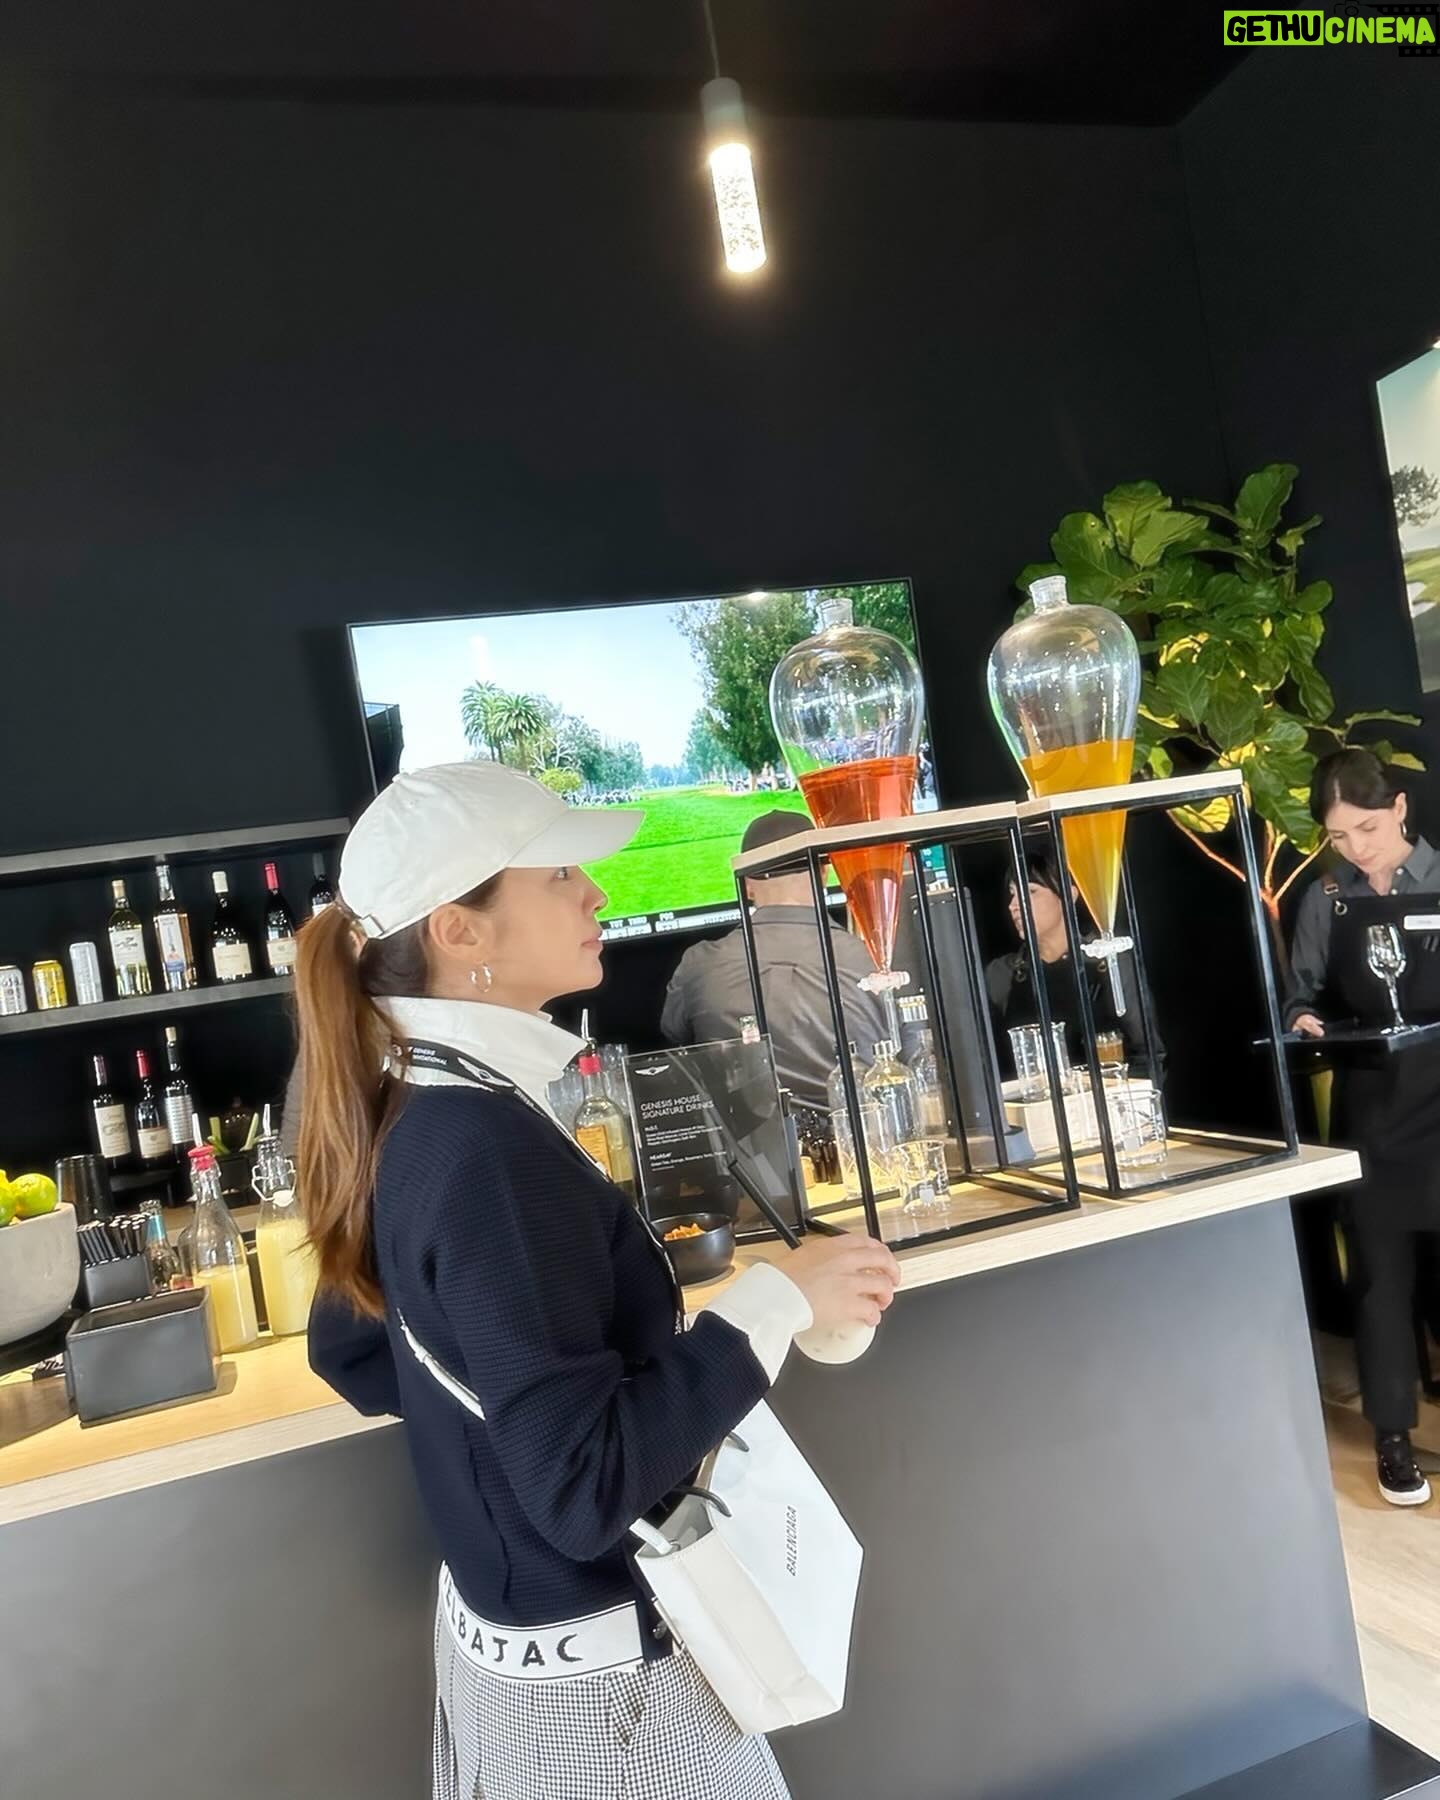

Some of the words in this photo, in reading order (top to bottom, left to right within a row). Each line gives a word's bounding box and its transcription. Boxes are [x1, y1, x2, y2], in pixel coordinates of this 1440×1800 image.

[641, 1099, 673, 1111] GENESIS
[674, 1094, 700, 1105] HOUSE
[642, 1105, 684, 1119] SIGNATURE
[685, 1100, 714, 1112] DRINKS
[786, 1505, 797, 1577] BALENCIAGA
